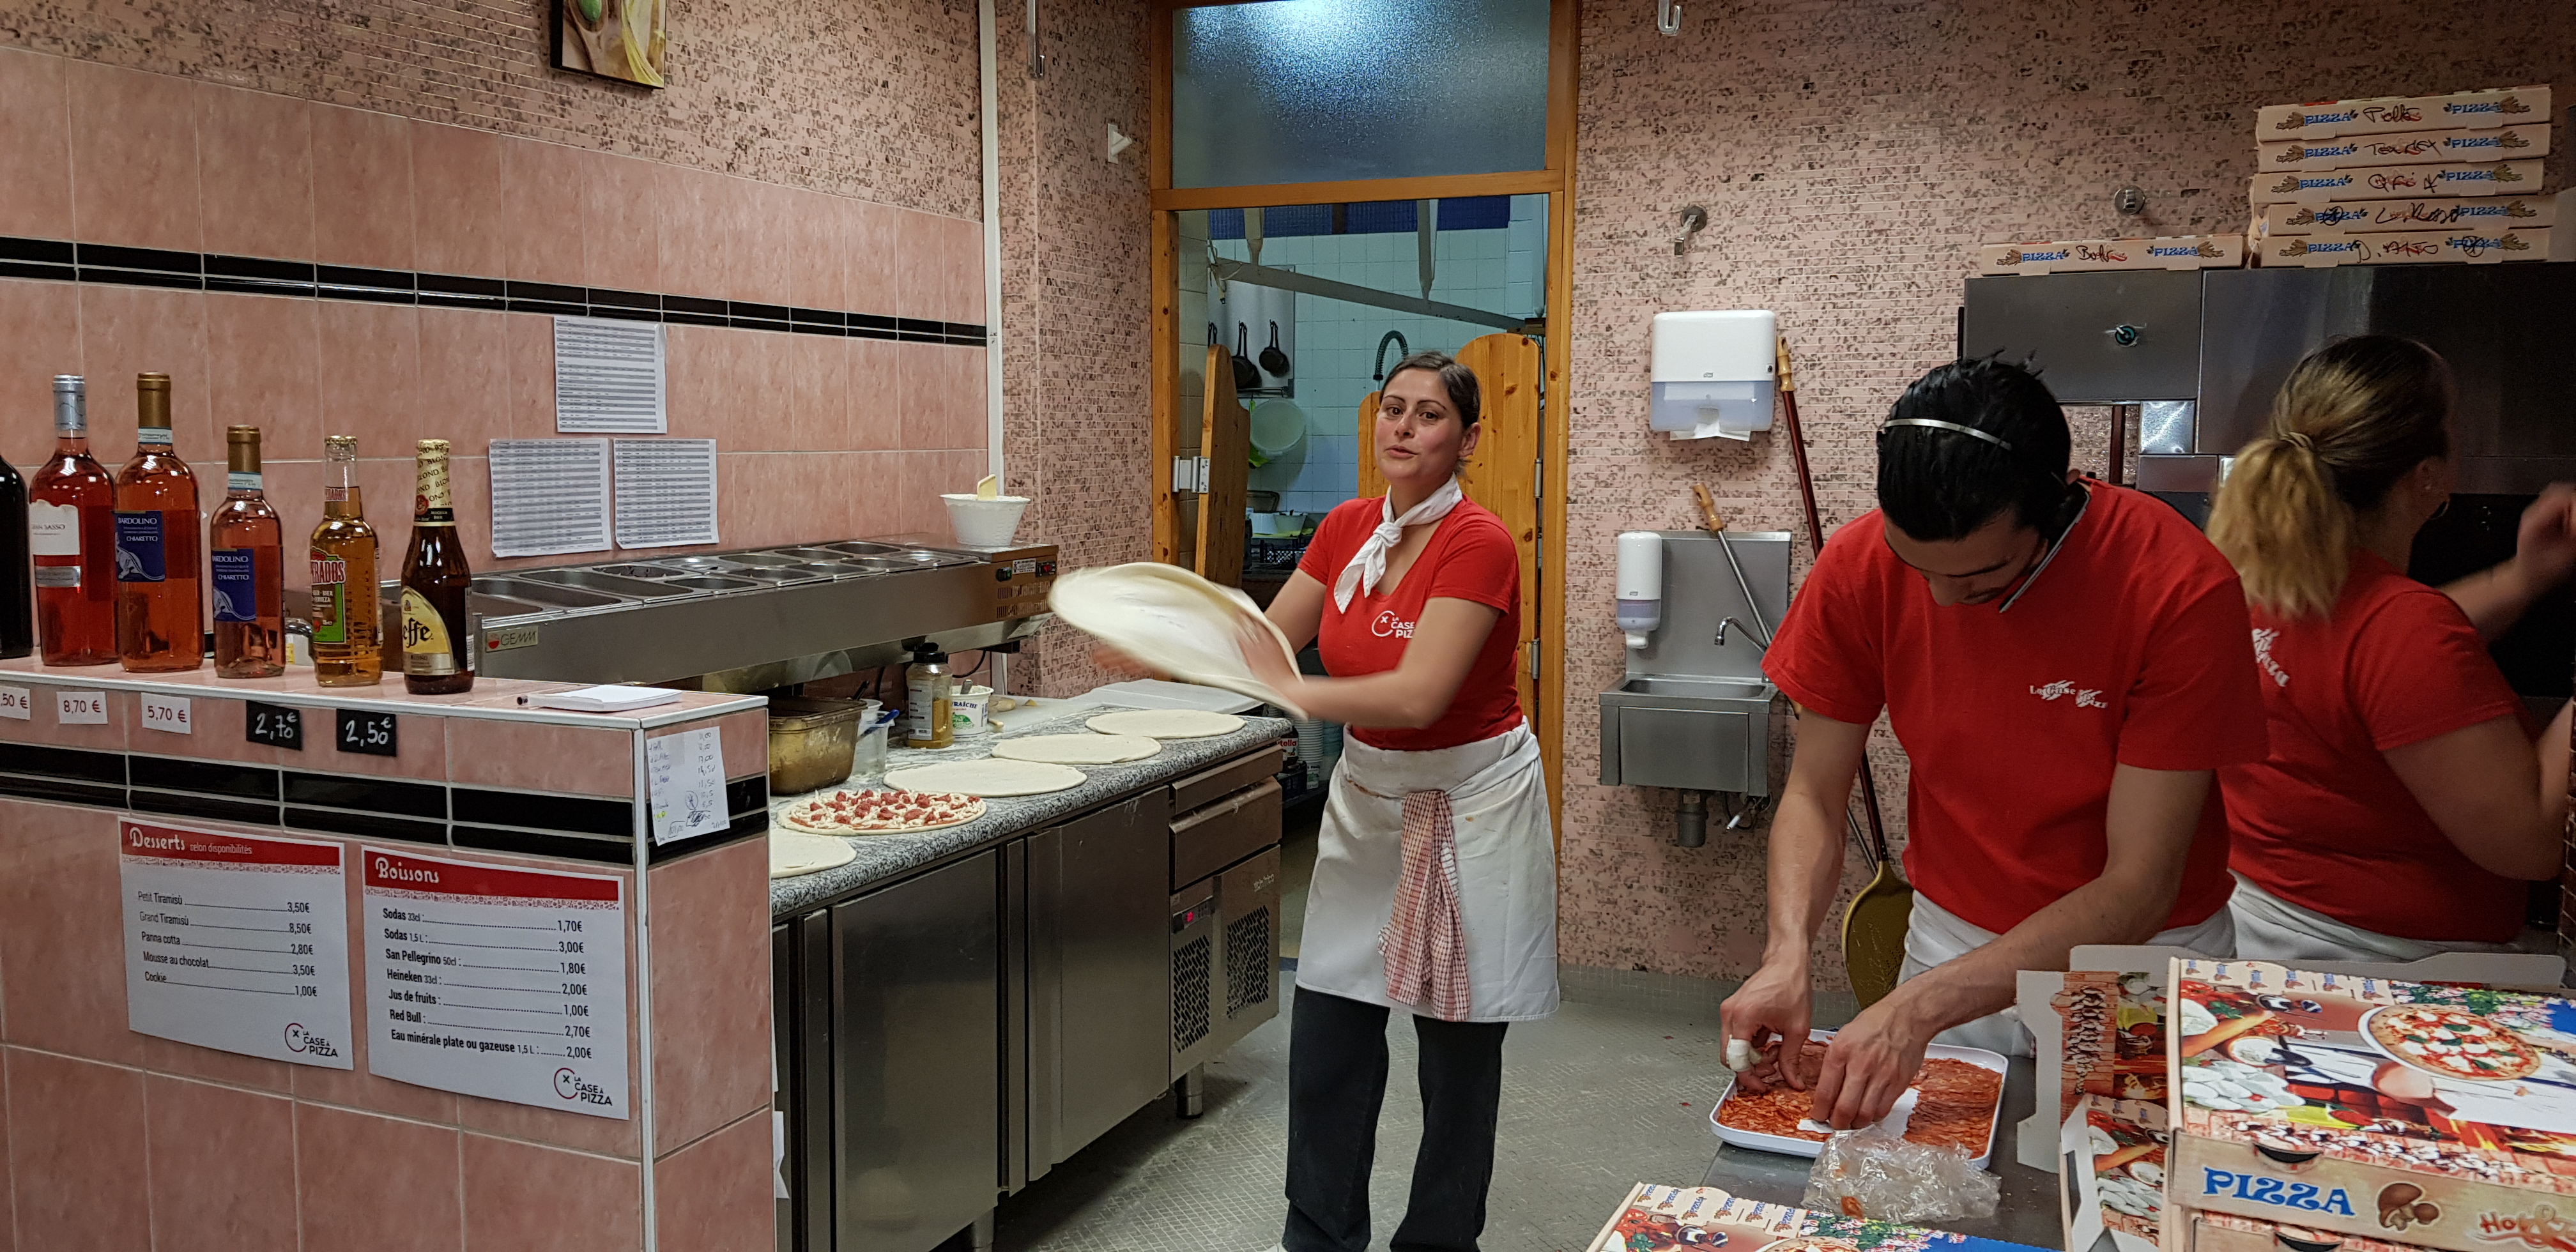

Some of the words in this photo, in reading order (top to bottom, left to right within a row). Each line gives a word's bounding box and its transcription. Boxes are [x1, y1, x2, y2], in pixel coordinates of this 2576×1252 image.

[2453, 103, 2501, 114] PIZZA
[2304, 112, 2350, 126] PIZZA
[2452, 137, 2501, 148] PIZZA
[2304, 146, 2351, 159] PIZZA
[2300, 178, 2346, 188] PIZZA
[2446, 171, 2496, 181] PIZZA
[2315, 209, 2361, 221] PIZZA
[2460, 205, 2509, 217] PIZZA
[2308, 243, 2354, 254] PIZZA
[2453, 237, 2501, 249] PIZZA
[2021, 252, 2064, 263] PIZZA
[2154, 246, 2199, 257] PIZZA
[403, 617, 433, 648] effe
[1391, 621, 1415, 630] CASE
[1395, 629, 1414, 638] PIZ
[20, 696, 29, 710] €
[63, 699, 87, 715] 8,70
[92, 699, 101, 713] €
[148, 705, 172, 721] 5,70
[178, 710, 187, 723] €
[129, 827, 186, 851] Desserts
[190, 841, 207, 852] selon
[208, 843, 252, 855] disponibilités
[375, 857, 440, 883] Boissons
[138, 890, 153, 902] Petit
[287, 902, 310, 914] 3,50€
[139, 911, 159, 922] Grand
[289, 922, 312, 935] 8,50€
[383, 908, 406, 920] Sodas
[408, 912, 421, 922] 33cl
[557, 920, 583, 933] 1,70€
[141, 931, 162, 943] Panna
[163, 935, 181, 945] cotta
[291, 944, 314, 956] 2,80€
[384, 928, 408, 941] Sodas
[410, 933, 418, 943] 1,5
[419, 934, 424, 942] L
[558, 941, 585, 954] 3,00€
[143, 950, 168, 964] Mousse
[169, 956, 178, 965] au
[180, 956, 210, 968] chocolat
[293, 964, 316, 977] 3,50€
[385, 948, 401, 960] San
[402, 950, 441, 966] Pellegrino
[443, 956, 457, 966] 50cl
[560, 962, 587, 975] 1,80€
[144, 971, 167, 983] Cookie
[295, 985, 318, 997] 1,00€
[387, 968, 422, 983] Heineken
[424, 975, 438, 985] 33cl
[562, 983, 588, 996] 2,00€
[388, 989, 402, 1002] Jus
[403, 991, 415, 1003] de
[415, 991, 437, 1005] fruits
[564, 1004, 590, 1017] 1,00€
[390, 1009, 405, 1022] Red
[406, 1011, 422, 1024] Bull
[565, 1025, 591, 1039] 2,70€
[303, 1036, 325, 1047] CASE
[391, 1029, 406, 1042] Eau
[406, 1031, 441, 1046] minérale
[443, 1034, 465, 1049] plate
[466, 1039, 477, 1050] ou
[479, 1041, 516, 1053] gazeuse
[517, 1044, 529, 1055] 1,5
[530, 1046, 535, 1055] L
[566, 1046, 592, 1060] 2,00€
[309, 1046, 339, 1058] PIZZA
[574, 1082, 599, 1094] CASE
[580, 1092, 613, 1106] PIZZA
[2204, 1166, 2356, 1218] PIZZA
